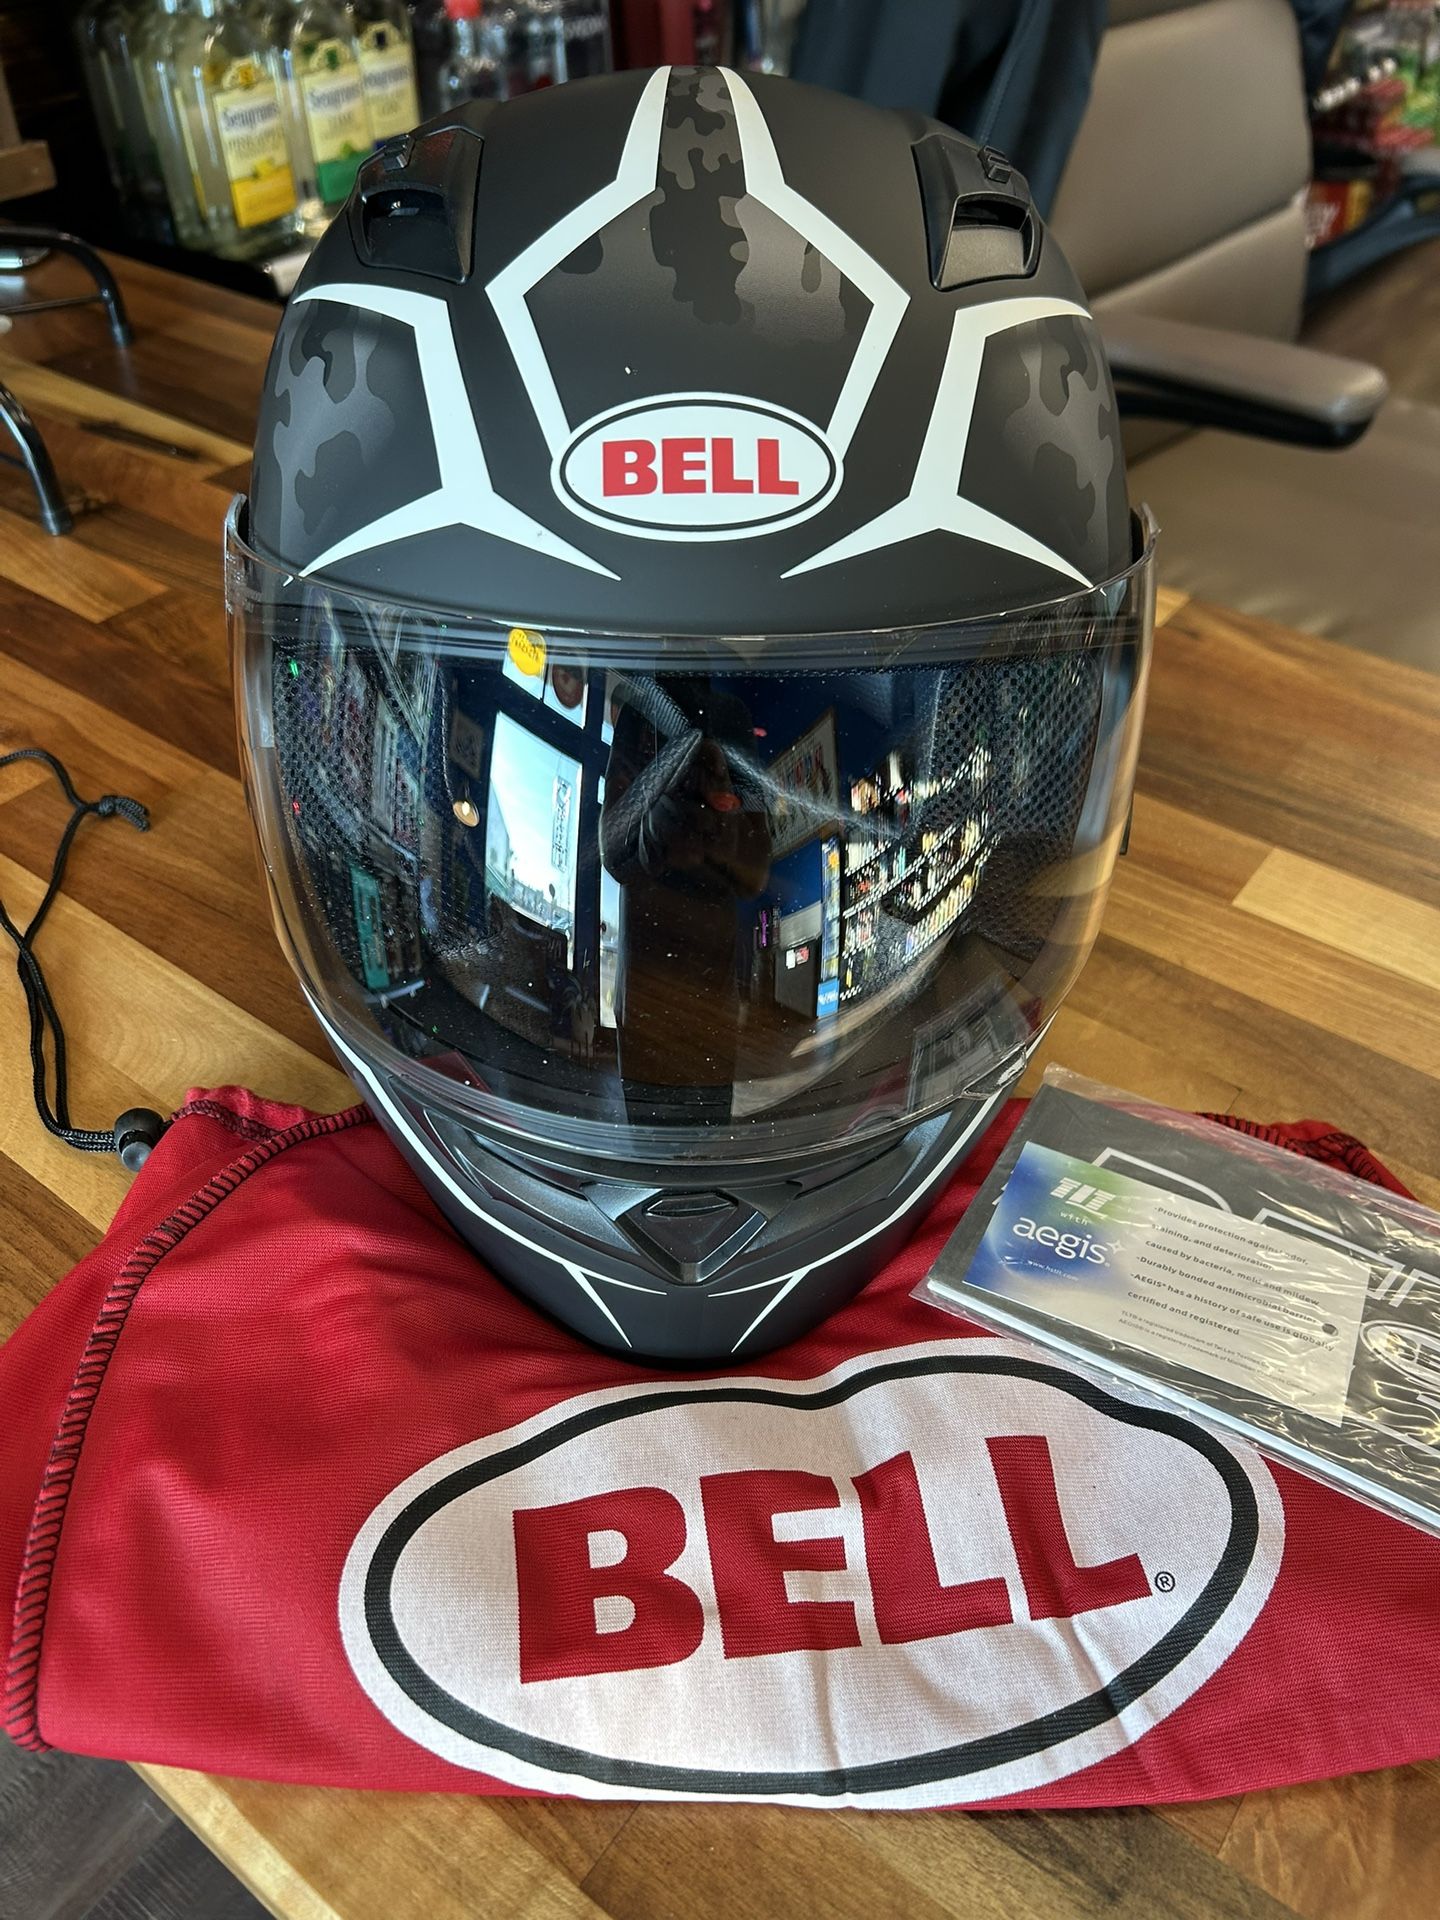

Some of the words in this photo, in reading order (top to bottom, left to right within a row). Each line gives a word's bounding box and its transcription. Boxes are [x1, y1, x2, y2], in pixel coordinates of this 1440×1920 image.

[602, 437, 800, 497] BELL
[1060, 1211, 1089, 1226] with
[1151, 1222, 1191, 1242] saining,
[1193, 1237, 1212, 1248] and
[1198, 1221, 1246, 1243] protection
[1145, 1239, 1178, 1255] caused
[1179, 1251, 1191, 1261] by
[1193, 1255, 1236, 1276] bacteria,
[1263, 1281, 1281, 1291] and
[1283, 1288, 1320, 1306] mildew
[1179, 1269, 1215, 1287] bonded
[1216, 1283, 1280, 1311] antimicrobial
[1283, 1307, 1317, 1323] barrier
[1127, 1289, 1167, 1309] certified
[1169, 1304, 1188, 1316] and
[1189, 1312, 1240, 1336] registered
[1167, 1285, 1184, 1295] has
[1194, 1294, 1228, 1311] history
[1229, 1307, 1240, 1315] of
[1241, 1311, 1262, 1323] safe
[1263, 1319, 1281, 1330] use
[1282, 1326, 1291, 1334] is
[513, 1436, 1153, 1684] BELL
